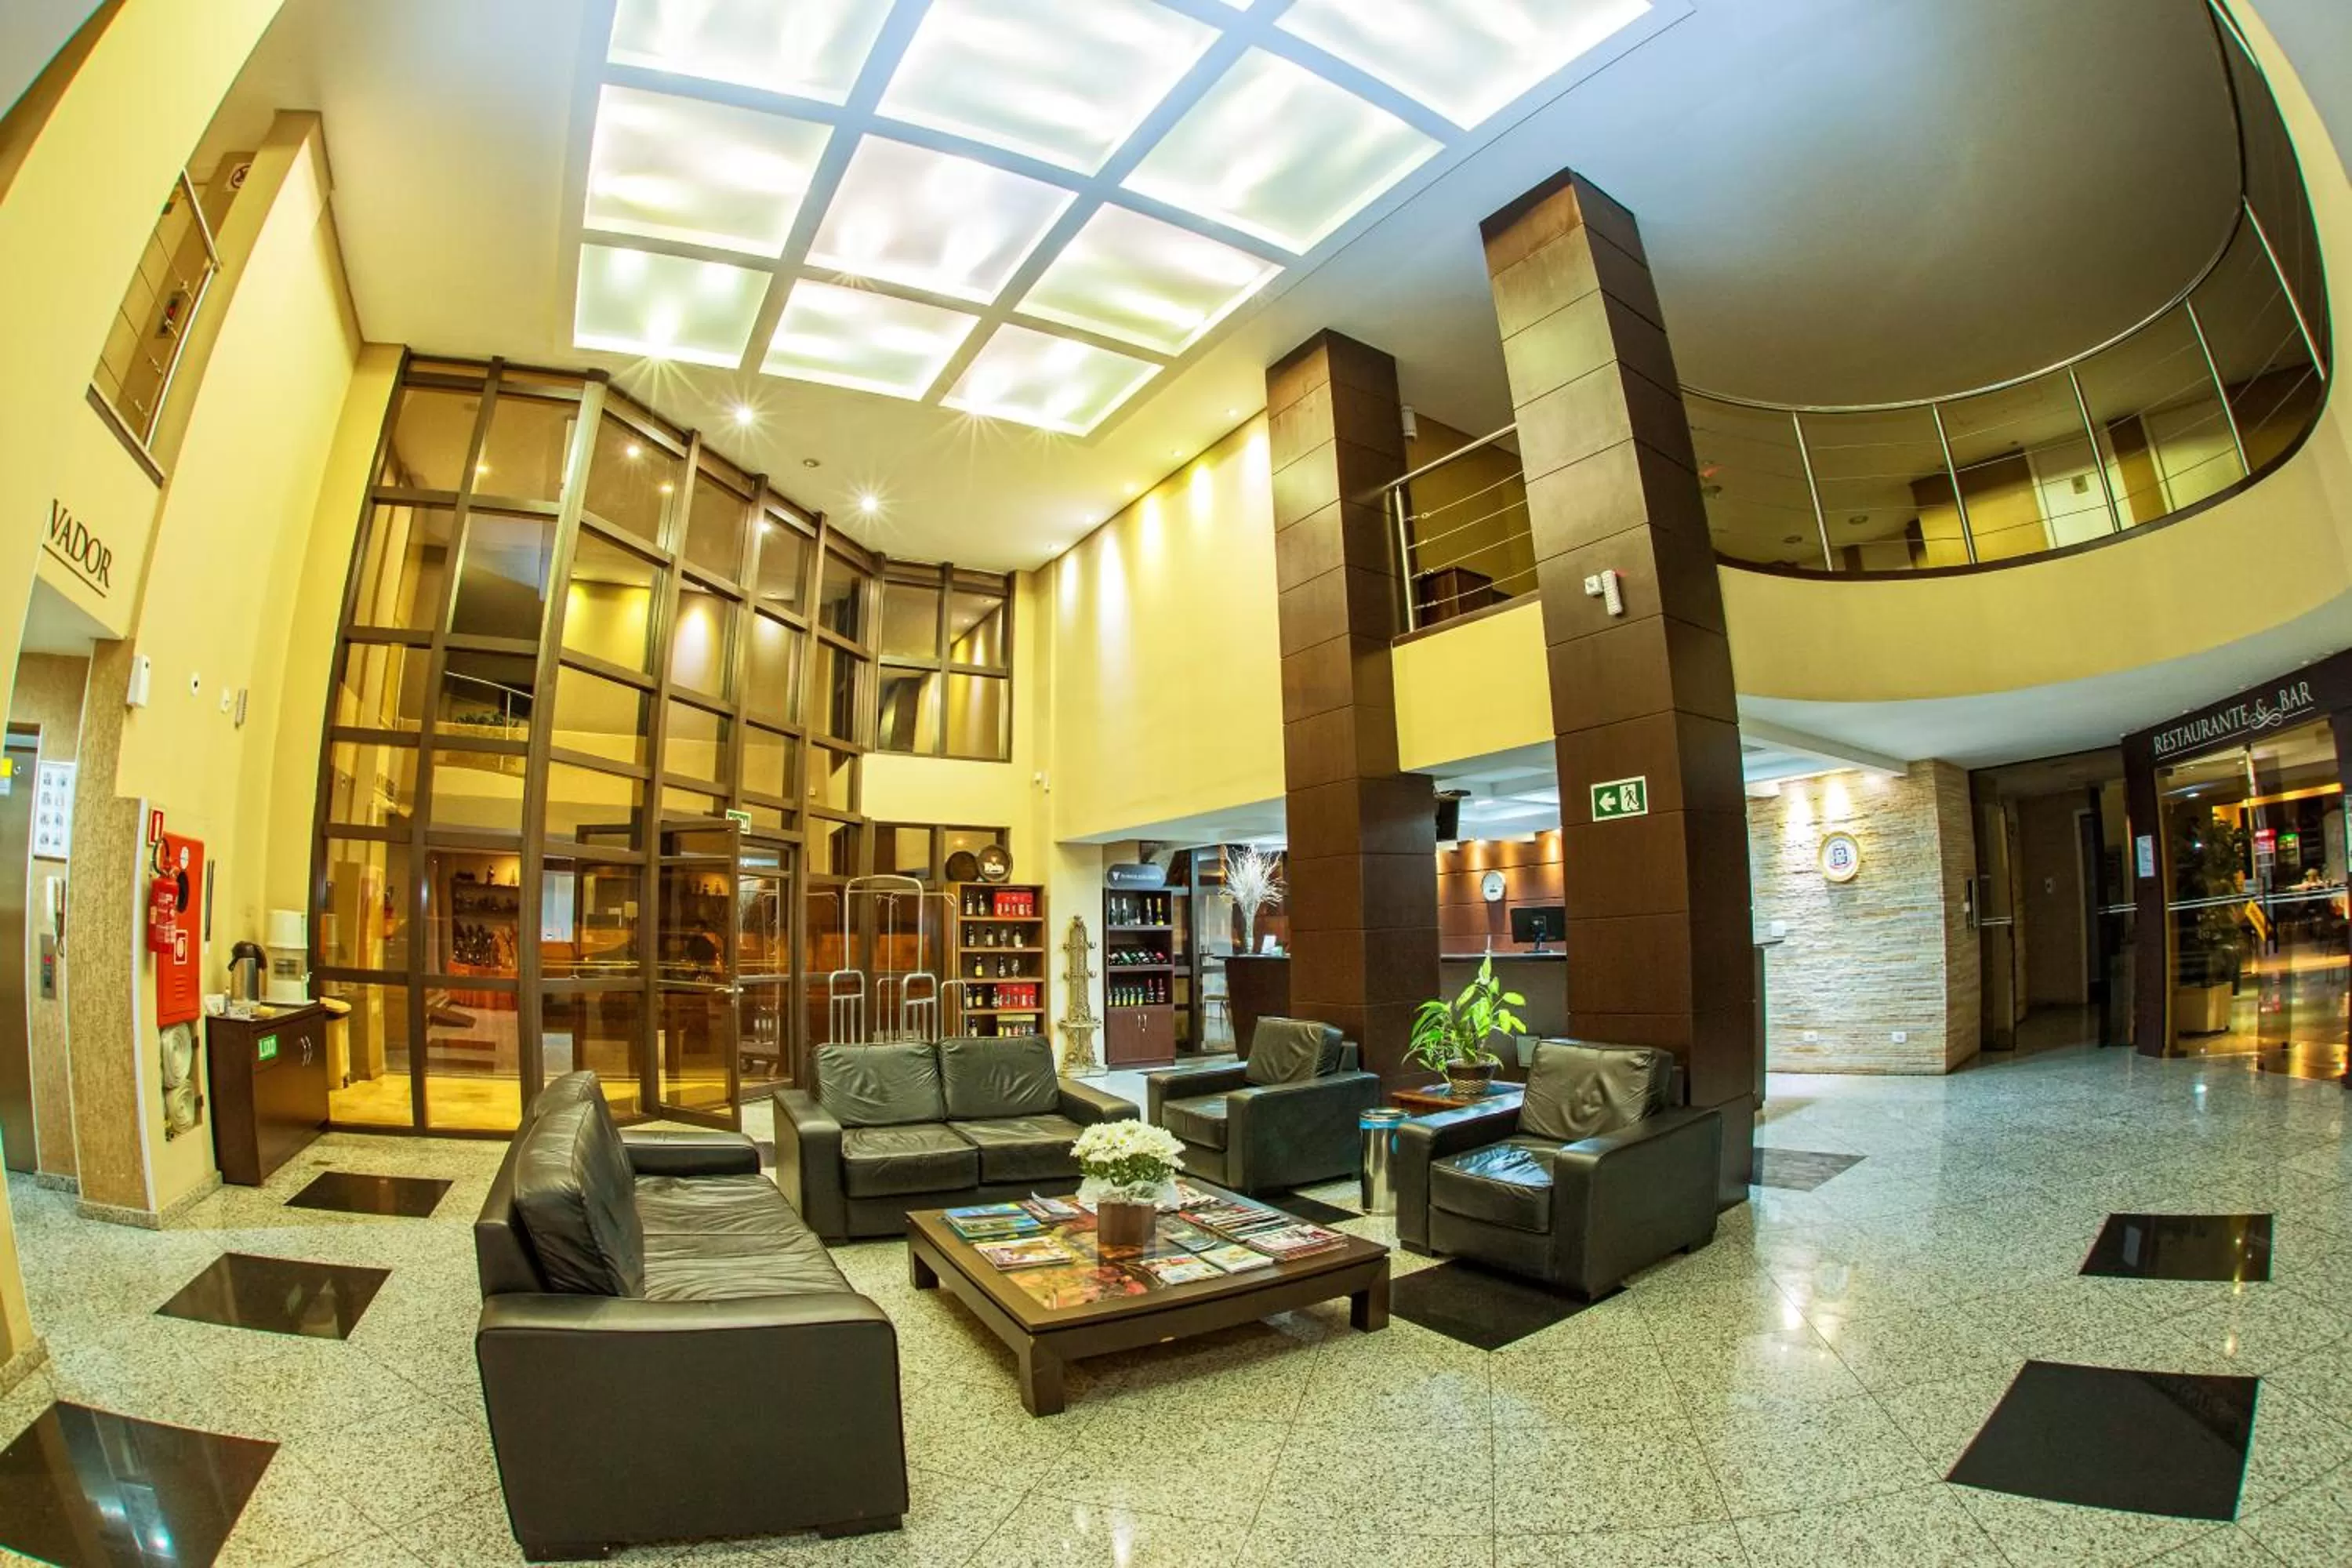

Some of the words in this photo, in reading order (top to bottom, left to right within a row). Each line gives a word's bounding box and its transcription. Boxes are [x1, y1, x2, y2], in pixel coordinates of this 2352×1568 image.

[51, 498, 112, 589] VADOR
[2154, 704, 2249, 754] RESTAURANTE
[2279, 681, 2314, 711] BAR
